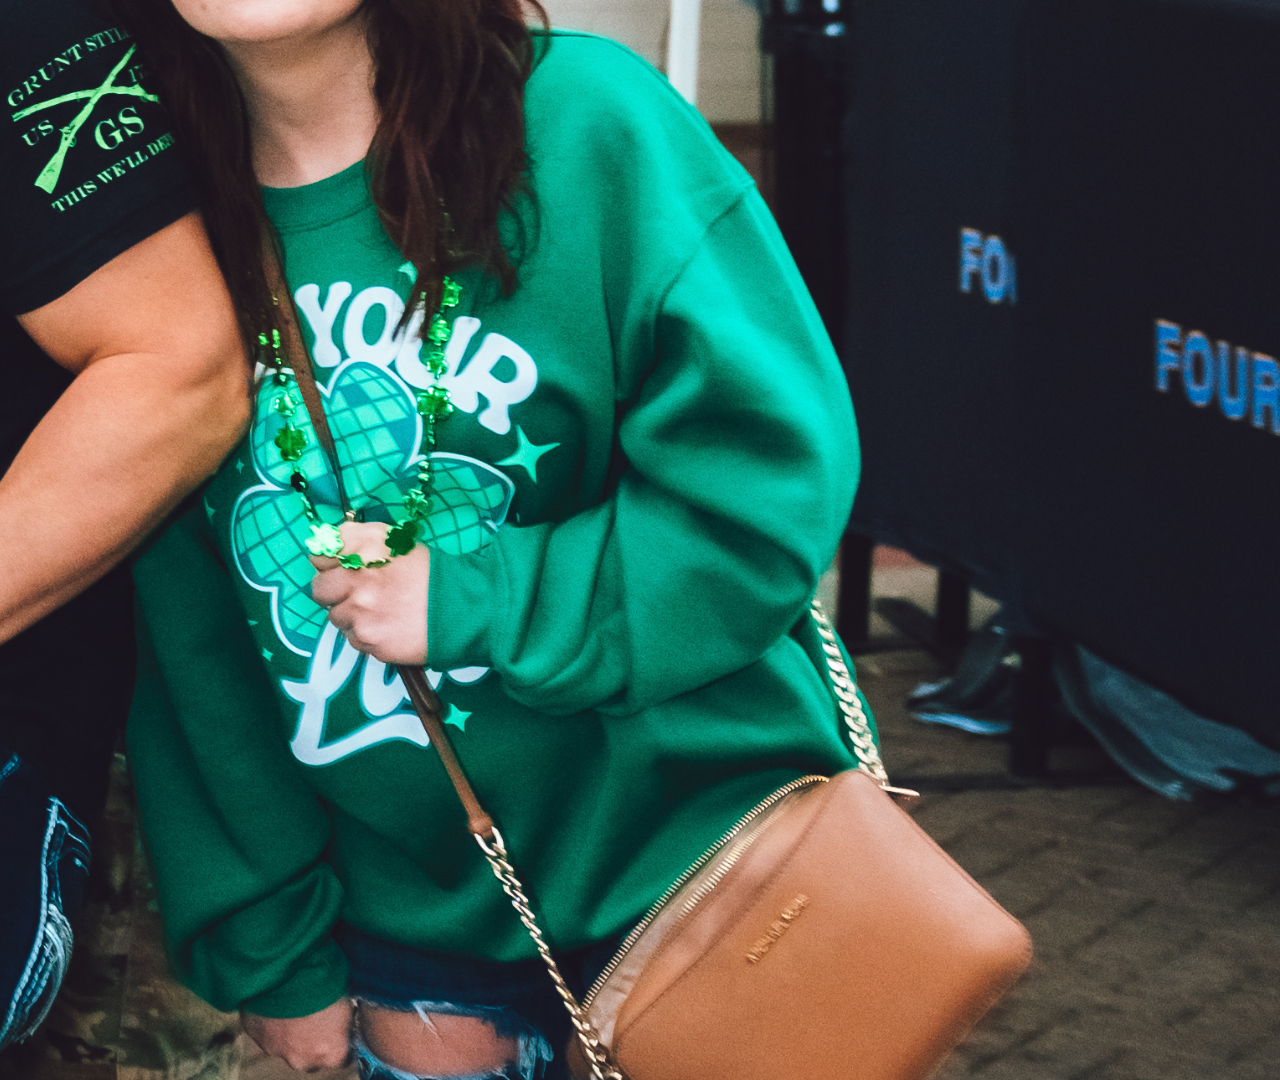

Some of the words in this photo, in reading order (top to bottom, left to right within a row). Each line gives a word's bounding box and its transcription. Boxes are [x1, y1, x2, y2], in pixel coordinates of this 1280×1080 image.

[7, 43, 82, 107] GRUNT
[21, 119, 54, 147] US
[94, 106, 145, 150] GS
[51, 180, 98, 212] THIS
[96, 150, 149, 184] WE'LL
[959, 226, 1017, 304] FO
[294, 281, 539, 435] YOUR
